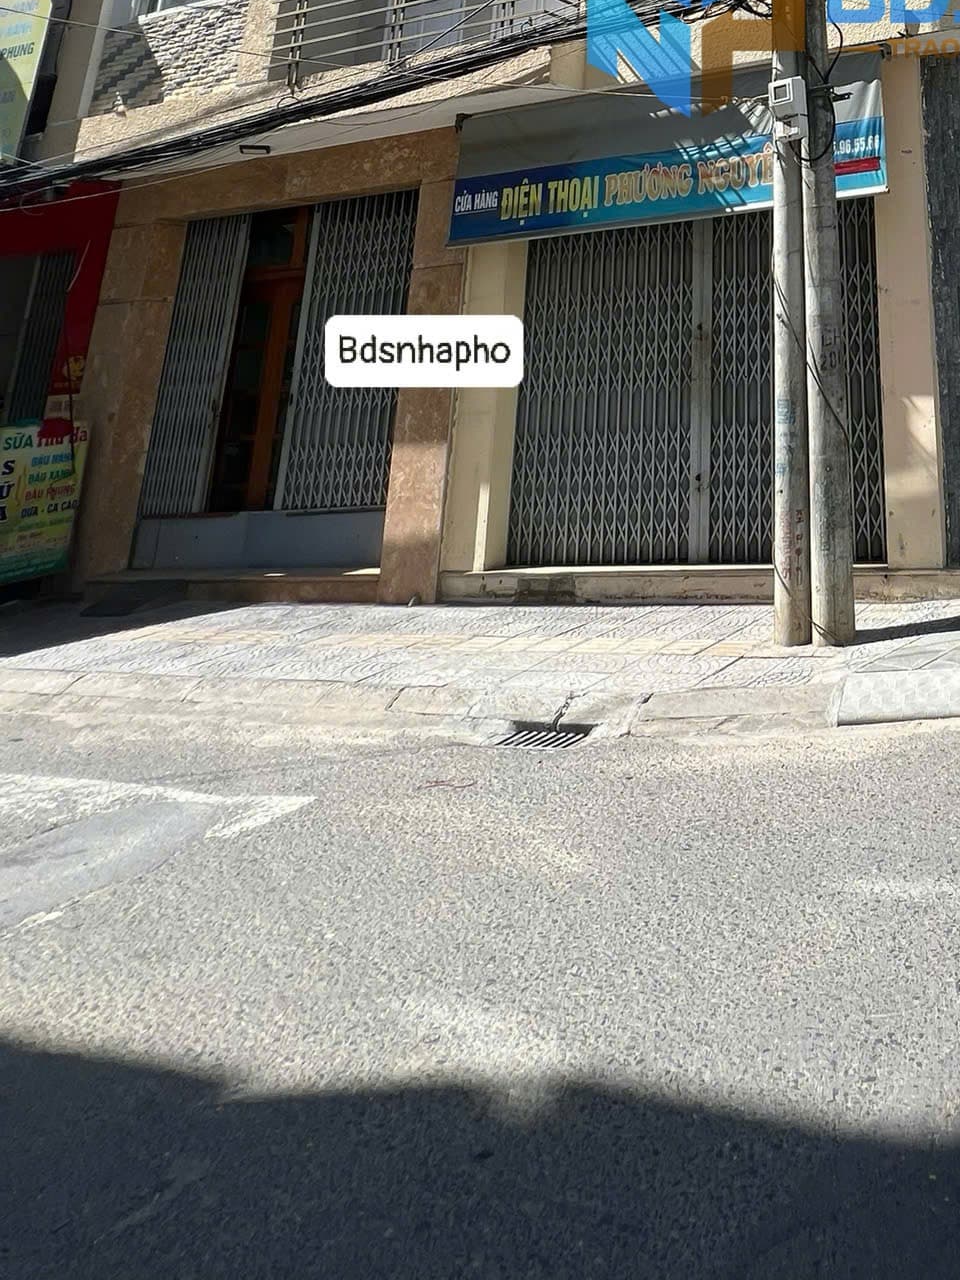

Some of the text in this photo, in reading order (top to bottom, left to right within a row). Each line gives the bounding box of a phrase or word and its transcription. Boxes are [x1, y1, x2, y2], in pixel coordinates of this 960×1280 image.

[454, 142, 774, 226] CỬA HÀNG ĐIỆN THOẠI PHƯƠNG NGUYÊ
